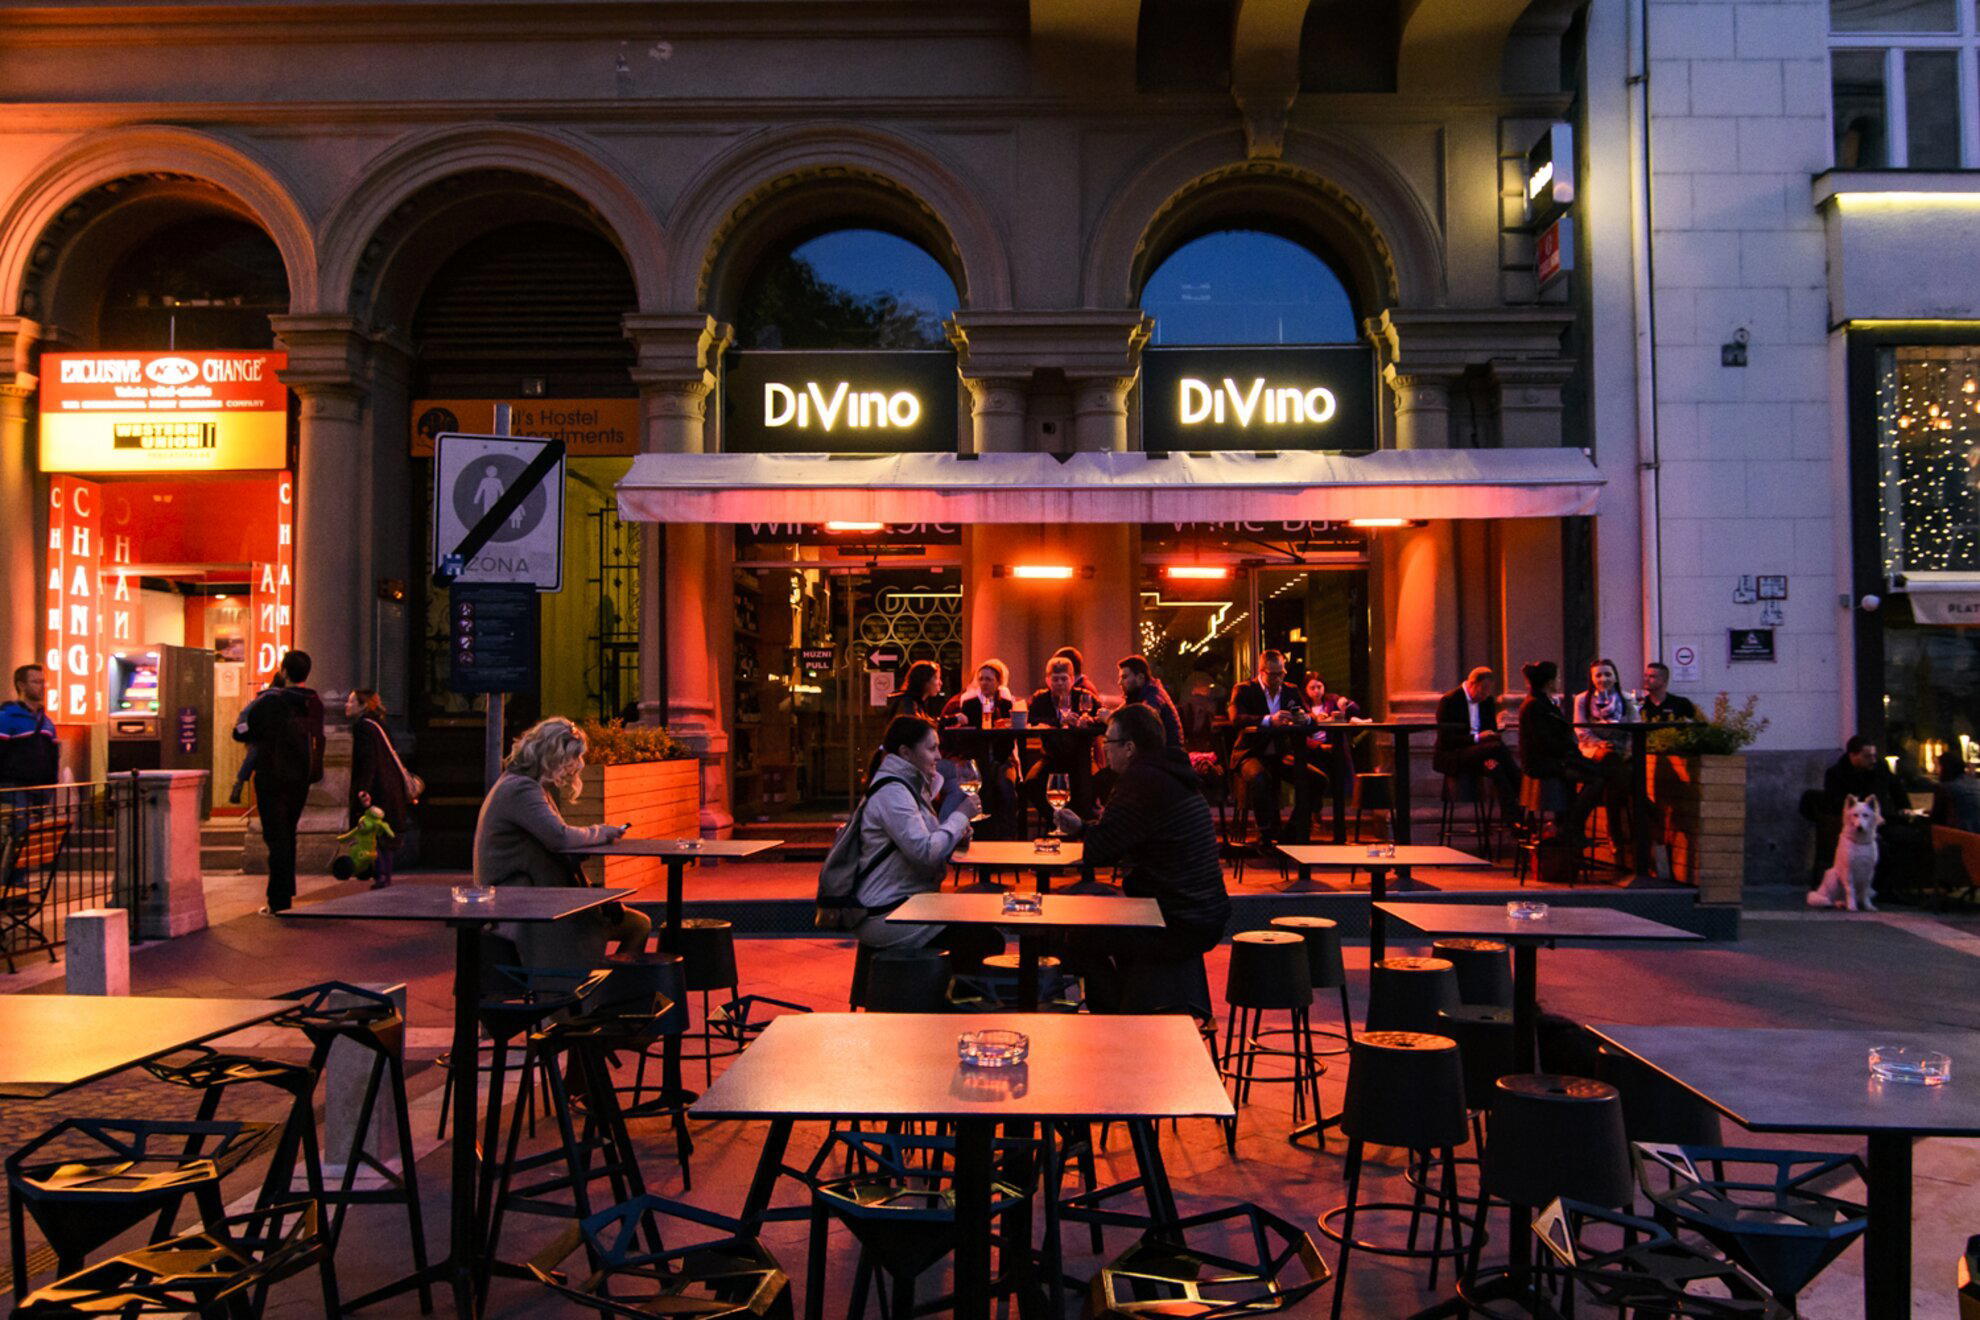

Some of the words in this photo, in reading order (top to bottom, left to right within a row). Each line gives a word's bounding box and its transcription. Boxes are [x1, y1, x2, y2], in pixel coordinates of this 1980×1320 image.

[541, 408, 598, 426] Hostel
[764, 382, 920, 431] DiVino
[1180, 378, 1336, 427] DiVino
[47, 487, 62, 711] CHANGE
[67, 486, 91, 715] CHANGE
[805, 661, 830, 669] PULL
